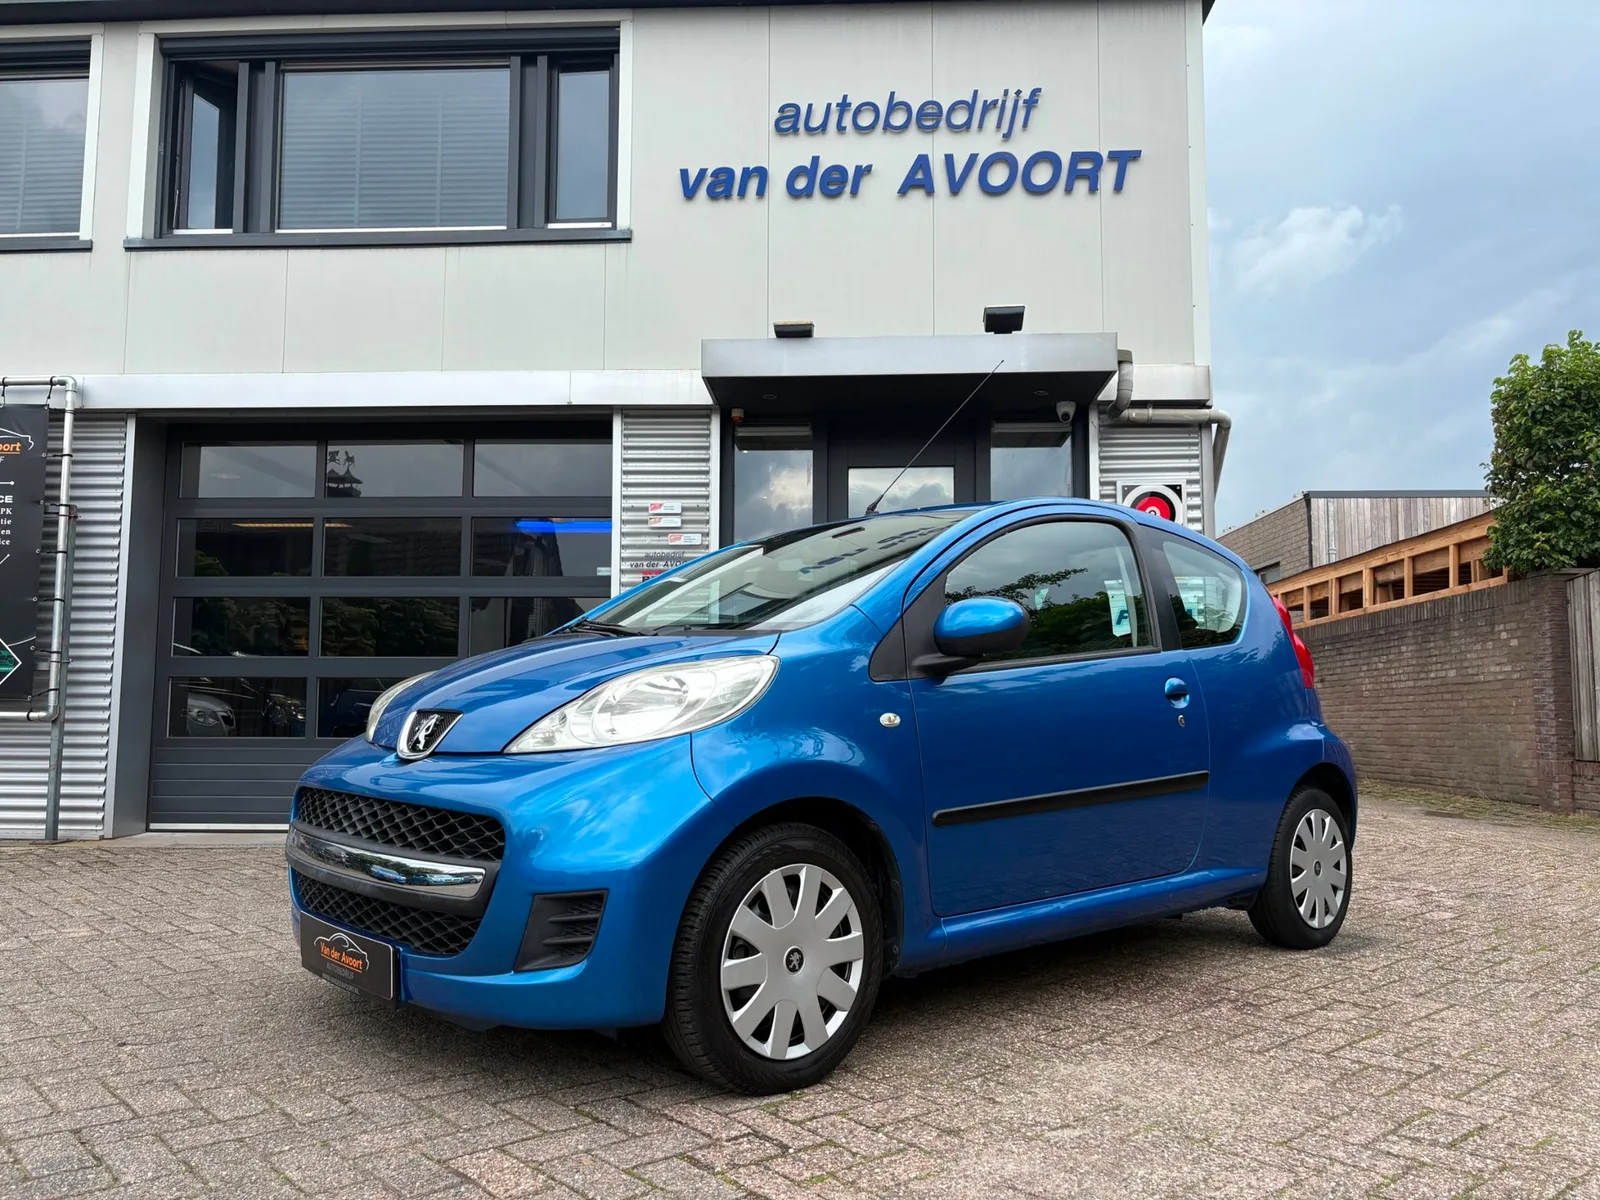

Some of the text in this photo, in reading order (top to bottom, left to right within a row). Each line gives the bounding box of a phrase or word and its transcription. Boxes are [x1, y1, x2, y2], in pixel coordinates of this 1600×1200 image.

[774, 88, 1042, 139] autobedrijf
[679, 149, 1142, 200] van der AVOORT
[321, 942, 331, 956] Van
[331, 947, 341, 960] der
[341, 953, 363, 970] Avoort
